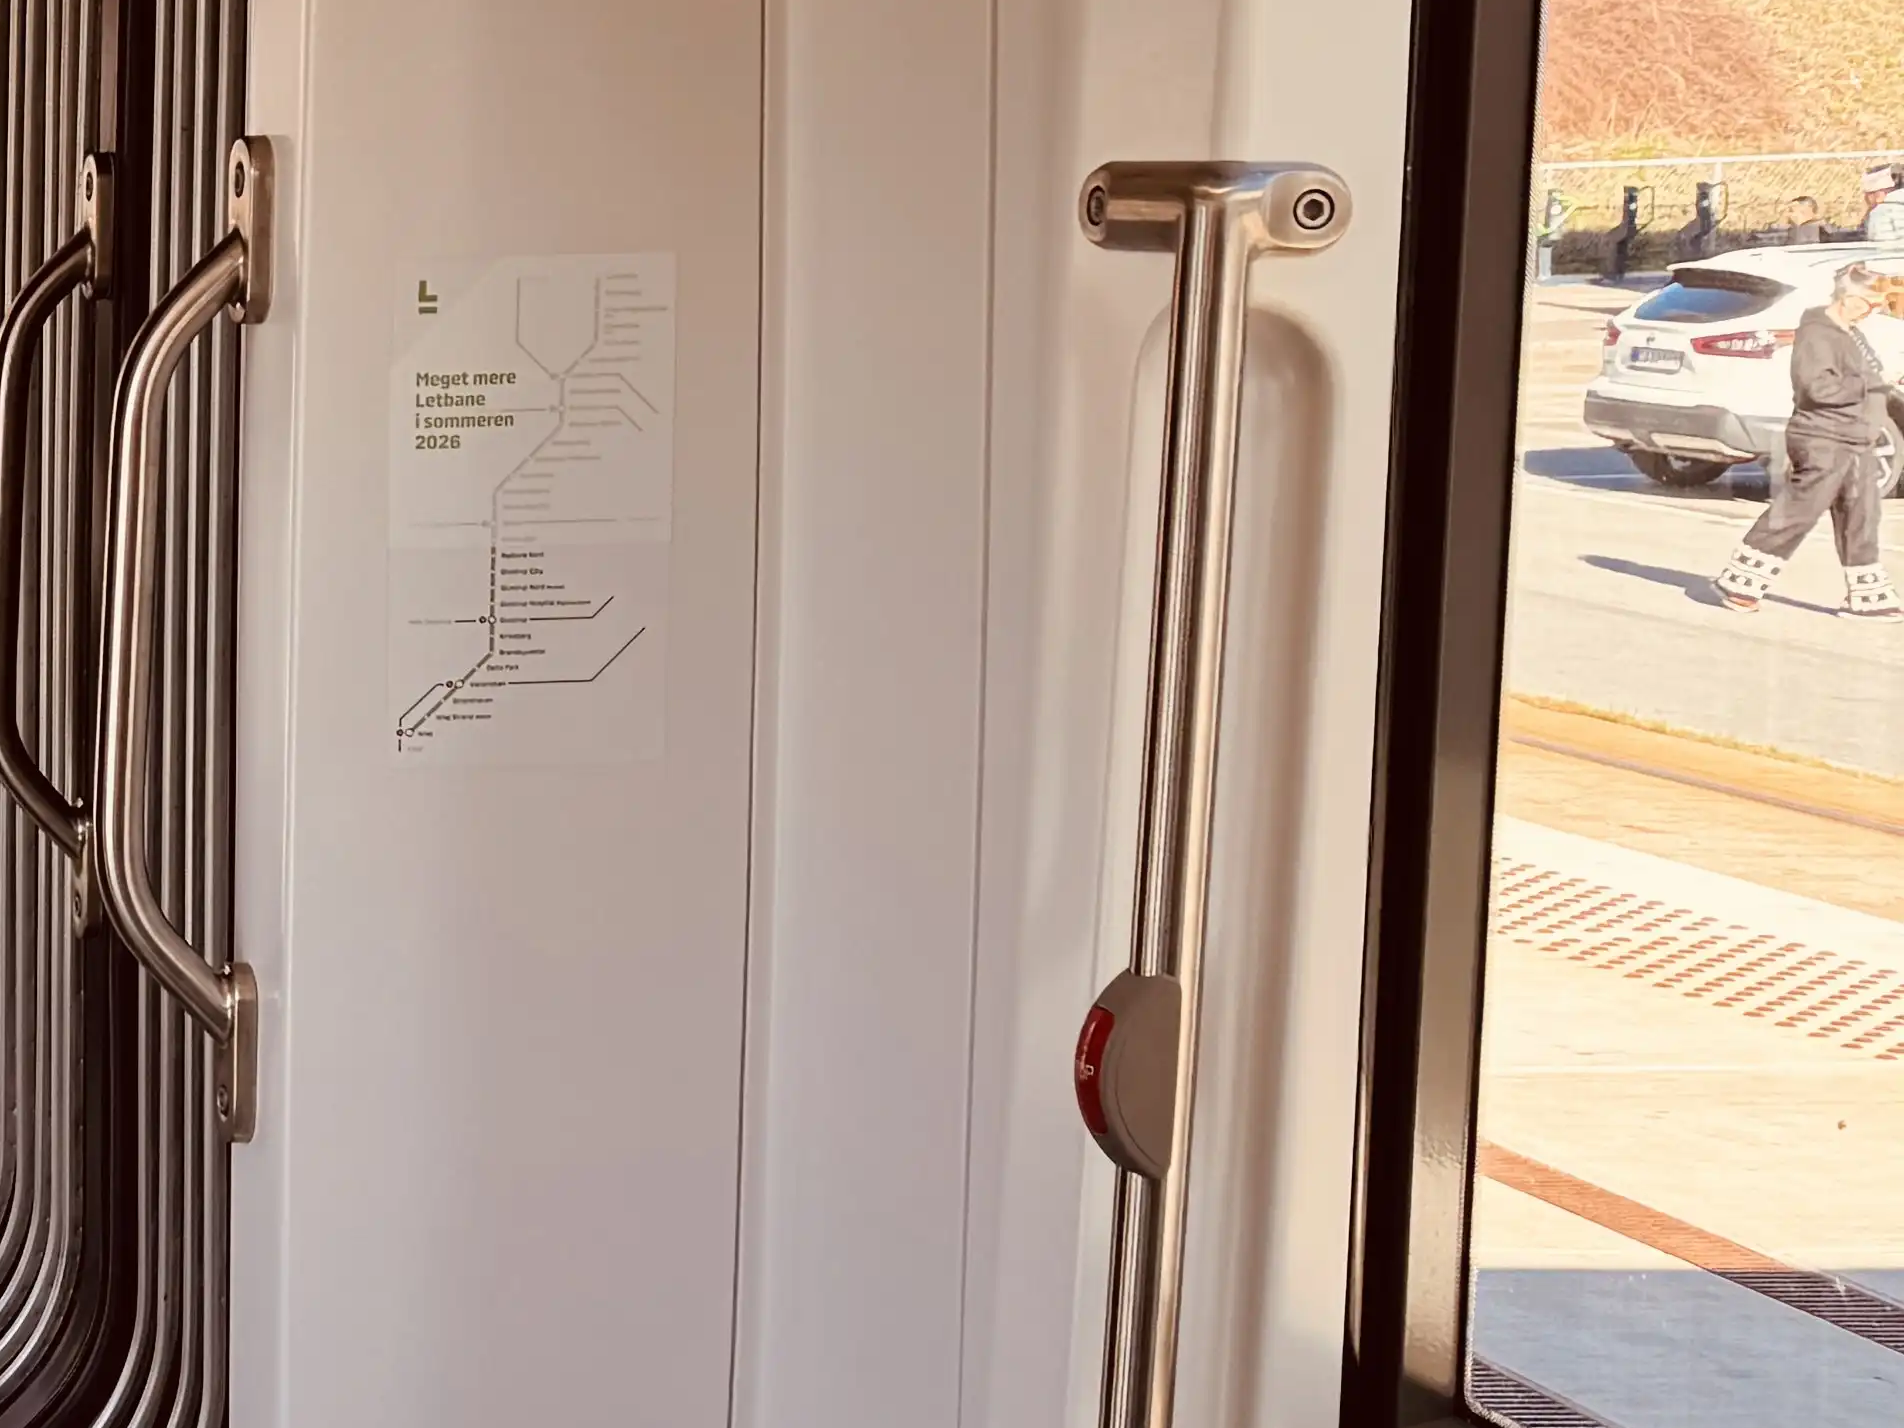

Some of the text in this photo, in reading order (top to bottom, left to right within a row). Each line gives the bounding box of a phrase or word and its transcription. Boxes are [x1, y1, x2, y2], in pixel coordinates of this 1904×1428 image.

[416, 372, 517, 390] Meget mere
[416, 392, 486, 408] Letbane
[415, 413, 515, 429] i sommeren
[415, 434, 461, 450] 2026
